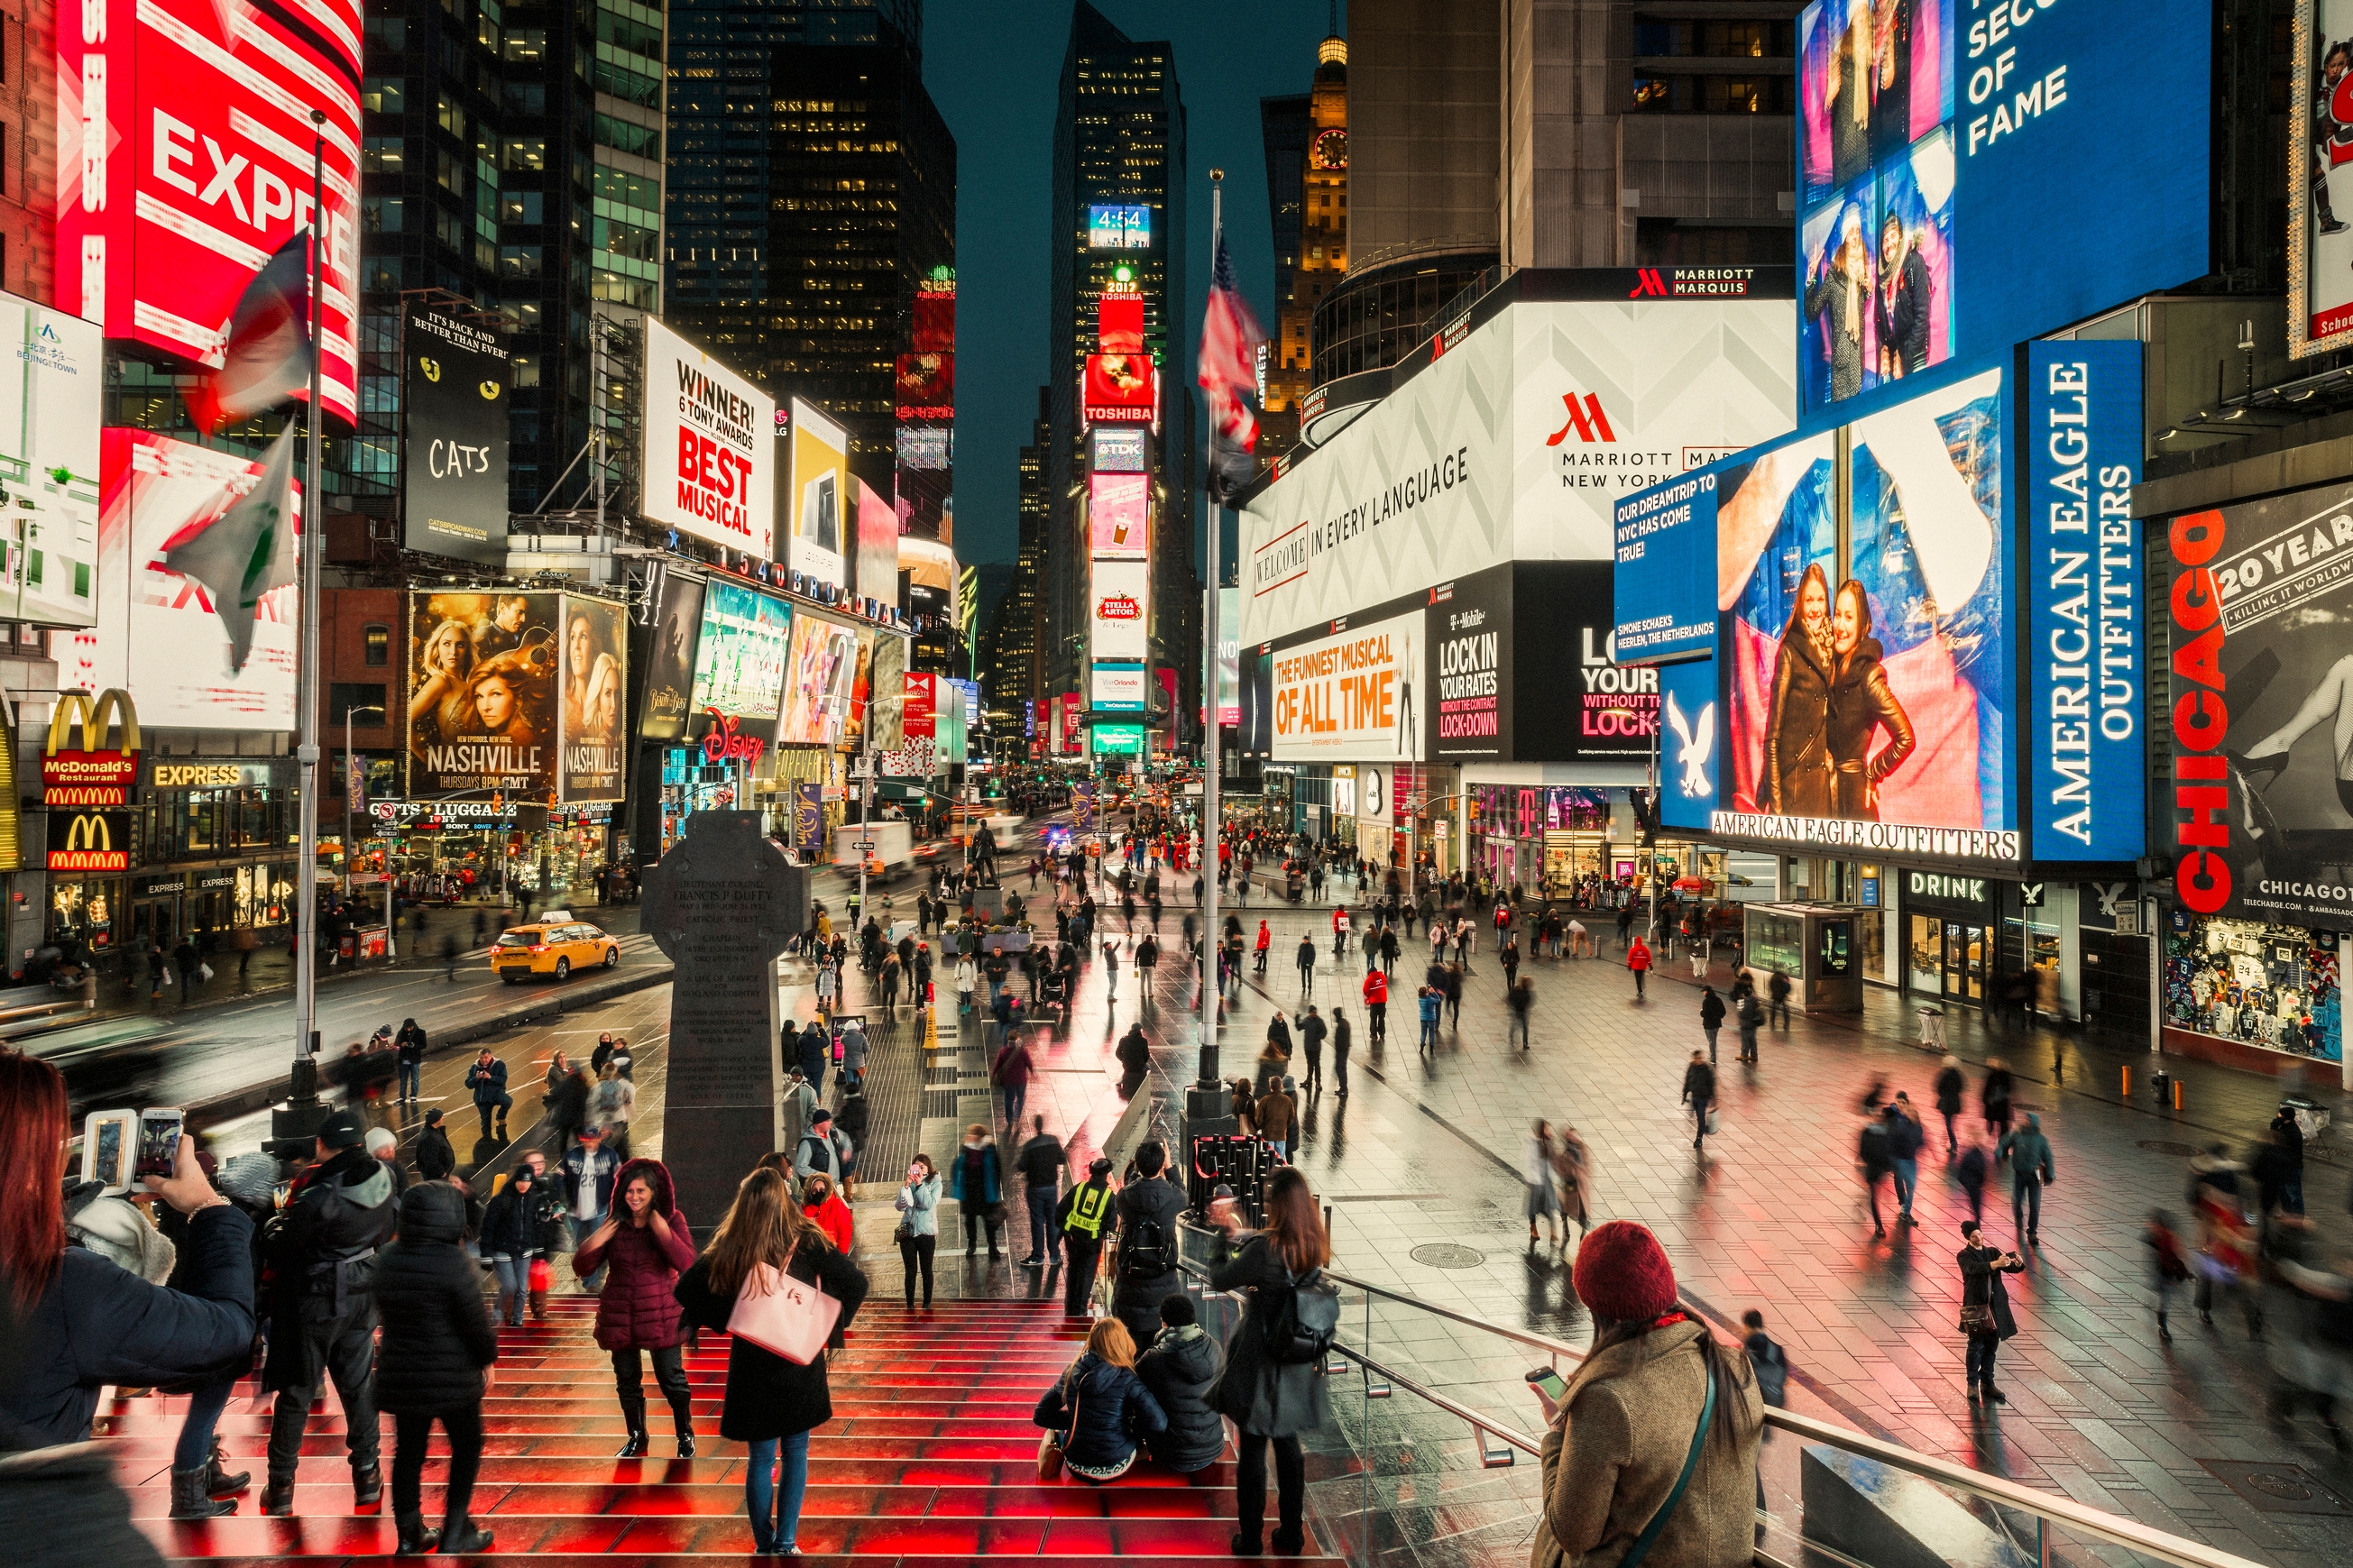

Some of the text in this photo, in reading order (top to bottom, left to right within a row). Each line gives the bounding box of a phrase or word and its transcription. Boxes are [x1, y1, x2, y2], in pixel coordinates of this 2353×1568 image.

[1968, 46, 2017, 105] OF
[1969, 64, 2067, 157] FAME
[1098, 210, 1141, 228] 4:54
[1674, 268, 1754, 280] MARRIOTT
[1100, 293, 1143, 301] TOSHIBA
[1107, 281, 1136, 293] 2017
[1674, 282, 1745, 294] MARQUIS
[428, 312, 495, 344] IT'S BACK AND
[1445, 312, 1472, 339] MARRIOTT
[453, 332, 480, 350] THAN
[1445, 324, 1468, 351] MARQUIS
[676, 357, 755, 434] WINNER!
[1303, 387, 1328, 409] MARRIOTT
[1086, 408, 1152, 420] TOSHIBA
[1303, 400, 1324, 421] MARQUIS
[679, 395, 754, 451] 6 TONY AWARDS
[774, 427, 787, 436] LG
[429, 438, 490, 479] CATS
[1109, 444, 1142, 454] TDK
[678, 424, 752, 506] BEST
[1562, 453, 1674, 466] MARRIOTT
[1562, 474, 1607, 488] NEW
[1617, 472, 1715, 523] OUR DREAMTRIP TO
[676, 480, 751, 536] MUSICAL
[1255, 445, 1468, 584] WELCOME IN EVERY LANGUAGE
[428, 518, 488, 536] CATSBROADWAY.COM
[1617, 504, 1691, 544] NYC HAS COME
[1617, 541, 1645, 564] TRUE!
[1437, 582, 1454, 594] MARRIOTT
[2218, 557, 2264, 601] 20
[1437, 591, 1453, 601] MARQUIS
[2048, 361, 2091, 847] AMERICAN EAGLE
[2099, 463, 2135, 742] OUTFITTERS
[2233, 587, 2292, 621] KILLING IT
[1617, 615, 1673, 636] SIMONE SCHAEKS
[1617, 621, 1714, 649] HEERLEN, THE NETHERLANDS
[1294, 646, 1340, 682] FUNNIEST
[1341, 633, 1393, 673] MUSICAL
[1439, 631, 1498, 676] LOCK IN
[1439, 670, 1497, 700] YOUR RATES
[1580, 667, 1659, 693] YOUR
[1275, 687, 1299, 736] OF
[1300, 681, 1337, 735] ALL
[1440, 696, 1497, 713] WITHOUT THE CONTRACT
[1583, 694, 1647, 708] WITHOUT
[2168, 509, 2231, 914] CHICAGO
[1439, 711, 1498, 738] LOCK-DOWN
[456, 735, 467, 743] NEW
[467, 735, 489, 743] EPISODES.
[44, 761, 133, 774] McDonald's
[427, 745, 541, 774] NASHVILLE
[565, 747, 620, 774] NASHVILLE
[774, 748, 819, 779] FOREVER
[59, 774, 117, 782] Restaurant
[154, 766, 242, 786] EXPRESS
[439, 775, 480, 789] THURSDAYS
[482, 776, 500, 788] 9PM
[571, 776, 592, 789] THURSDAYS
[601, 775, 614, 788] CMT
[582, 802, 613, 812] LUGGAGE
[1714, 812, 2018, 860] AMERICAN EAGLE OUTFITTERS
[149, 882, 185, 894] EXPRESS
[201, 876, 234, 889] EXPRESS
[680, 880, 765, 888] LIEUTENANT COLONEL
[1910, 871, 1985, 903] DRINK
[673, 890, 773, 901] FRANCIS P DUFFY
[2243, 898, 2302, 911] TELECHARGE.COM
[685, 915, 759, 923] CATHOLIC PRIEST
[703, 934, 741, 942] CHAPLAIN
[724, 945, 759, 953] INFANTRY
[2180, 963, 2188, 975] 13
[2238, 965, 2250, 976] 24
[2316, 1013, 2326, 1025] 21
[2331, 1040, 2337, 1048] 7
